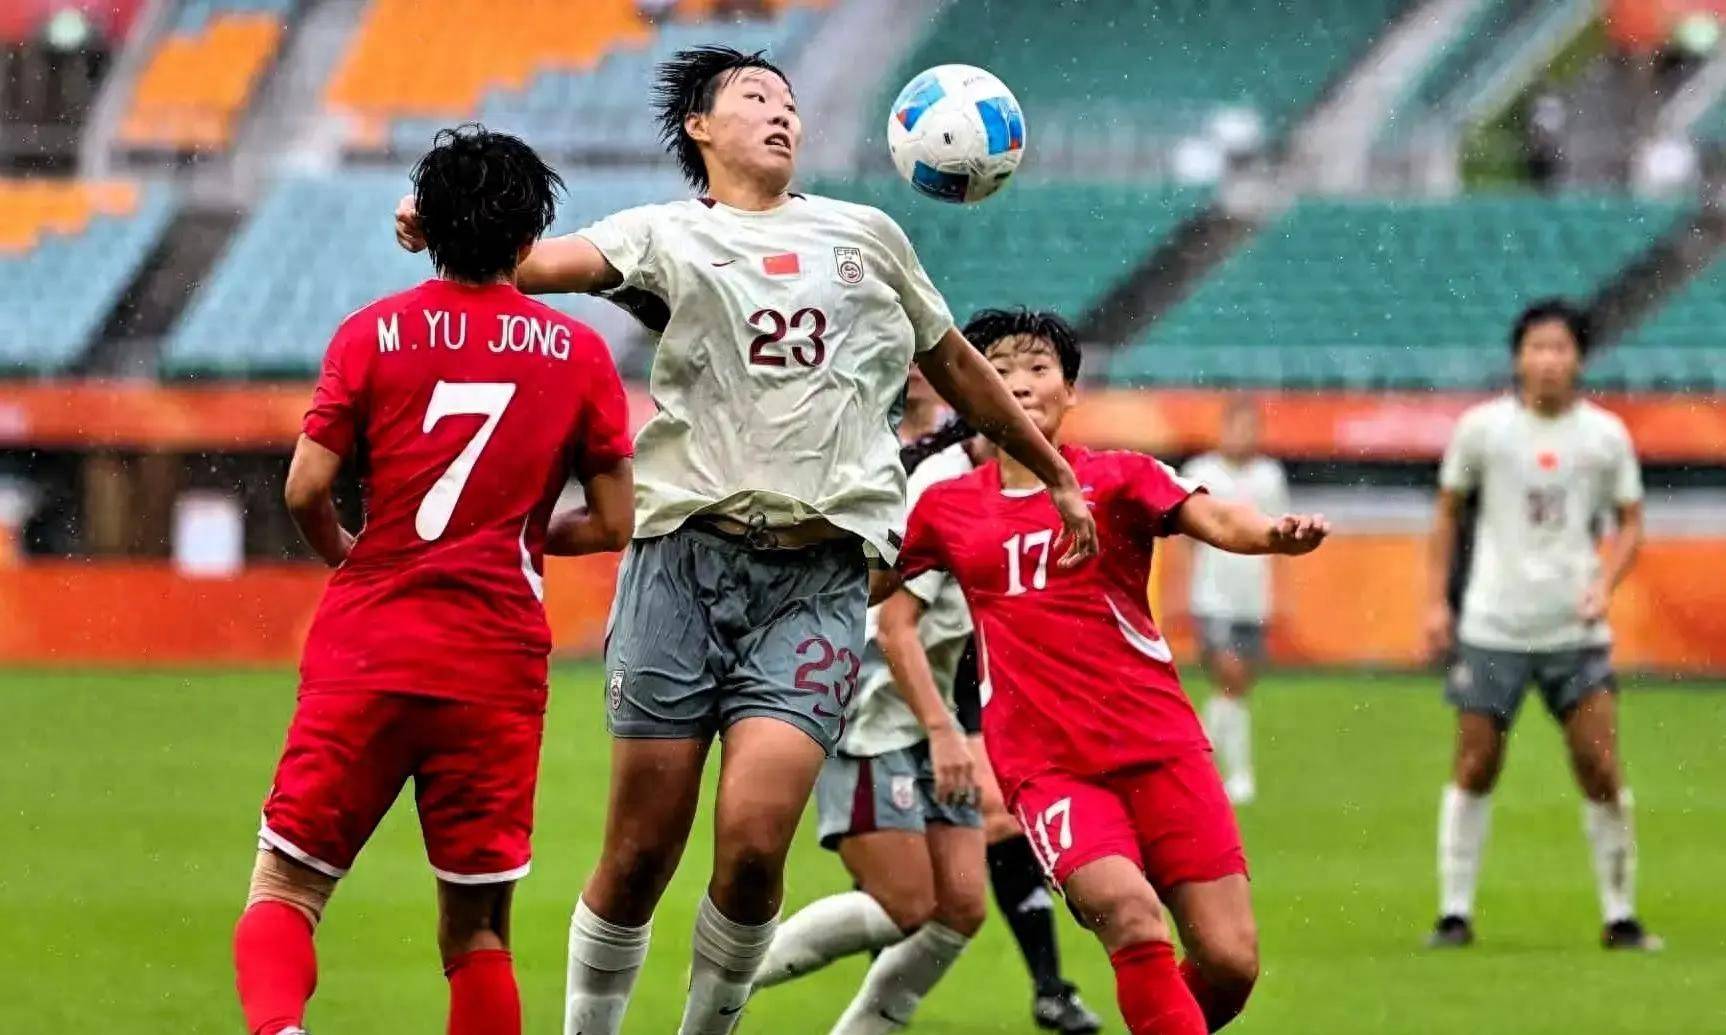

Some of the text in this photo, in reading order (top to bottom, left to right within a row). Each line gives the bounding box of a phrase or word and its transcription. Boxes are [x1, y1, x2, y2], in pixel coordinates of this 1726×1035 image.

[487, 314, 571, 361] JONG
[749, 307, 826, 367] 23
[415, 379, 517, 541] 7
[1002, 528, 1053, 596] 17
[794, 635, 861, 708] 23
[1034, 796, 1073, 871] 17
